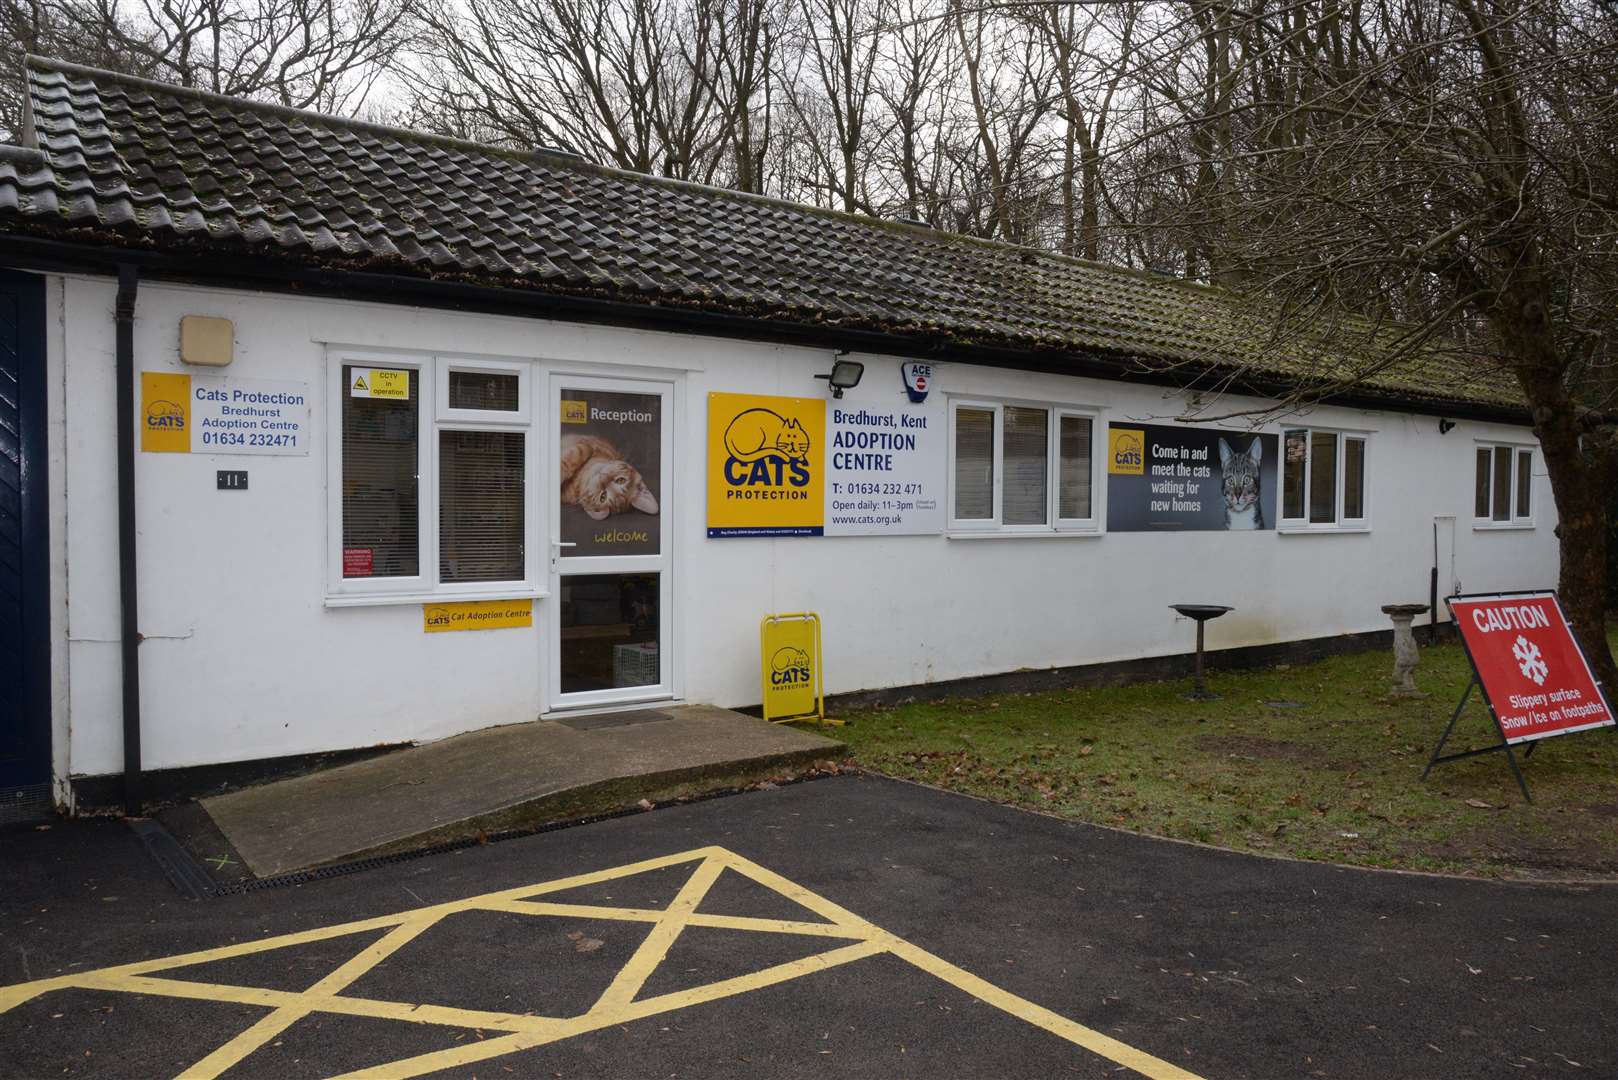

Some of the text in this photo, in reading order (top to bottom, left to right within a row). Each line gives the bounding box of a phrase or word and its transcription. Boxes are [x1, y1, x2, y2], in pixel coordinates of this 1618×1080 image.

[912, 364, 931, 376] ACE
[196, 388, 304, 405] Cats Protection
[222, 406, 280, 418] Bredhurst
[591, 407, 652, 424] Reception
[833, 409, 927, 430] Bredhurst, Kent
[147, 415, 185, 427] CATS
[202, 417, 299, 431] Adoption Centre
[203, 431, 297, 447] 01634 232471
[833, 431, 915, 451] ADOPTION
[1116, 451, 1141, 464] CATS
[1152, 443, 1208, 460] Come in and
[833, 452, 893, 471] CENTRE
[724, 455, 810, 487] CATS
[1152, 462, 1211, 478] meet the cats
[227, 474, 238, 486] 11
[727, 490, 808, 500] PROTECTION
[833, 483, 923, 495] T: 01634 232 471
[1152, 480, 1200, 497] waiting for
[832, 500, 855, 513] Open
[857, 500, 880, 512] daily:
[1151, 498, 1201, 512] new homes
[832, 514, 902, 526] www.cats.org.uk
[594, 528, 649, 543] welcome
[427, 615, 449, 625] CATS
[451, 608, 532, 621] Cat Adoption Centre
[1472, 604, 1550, 633] CAUTION
[771, 667, 810, 685] CATS
[1509, 688, 1581, 710] Slippery surface
[1550, 712, 1561, 722] on
[1561, 702, 1605, 720] footpaths
